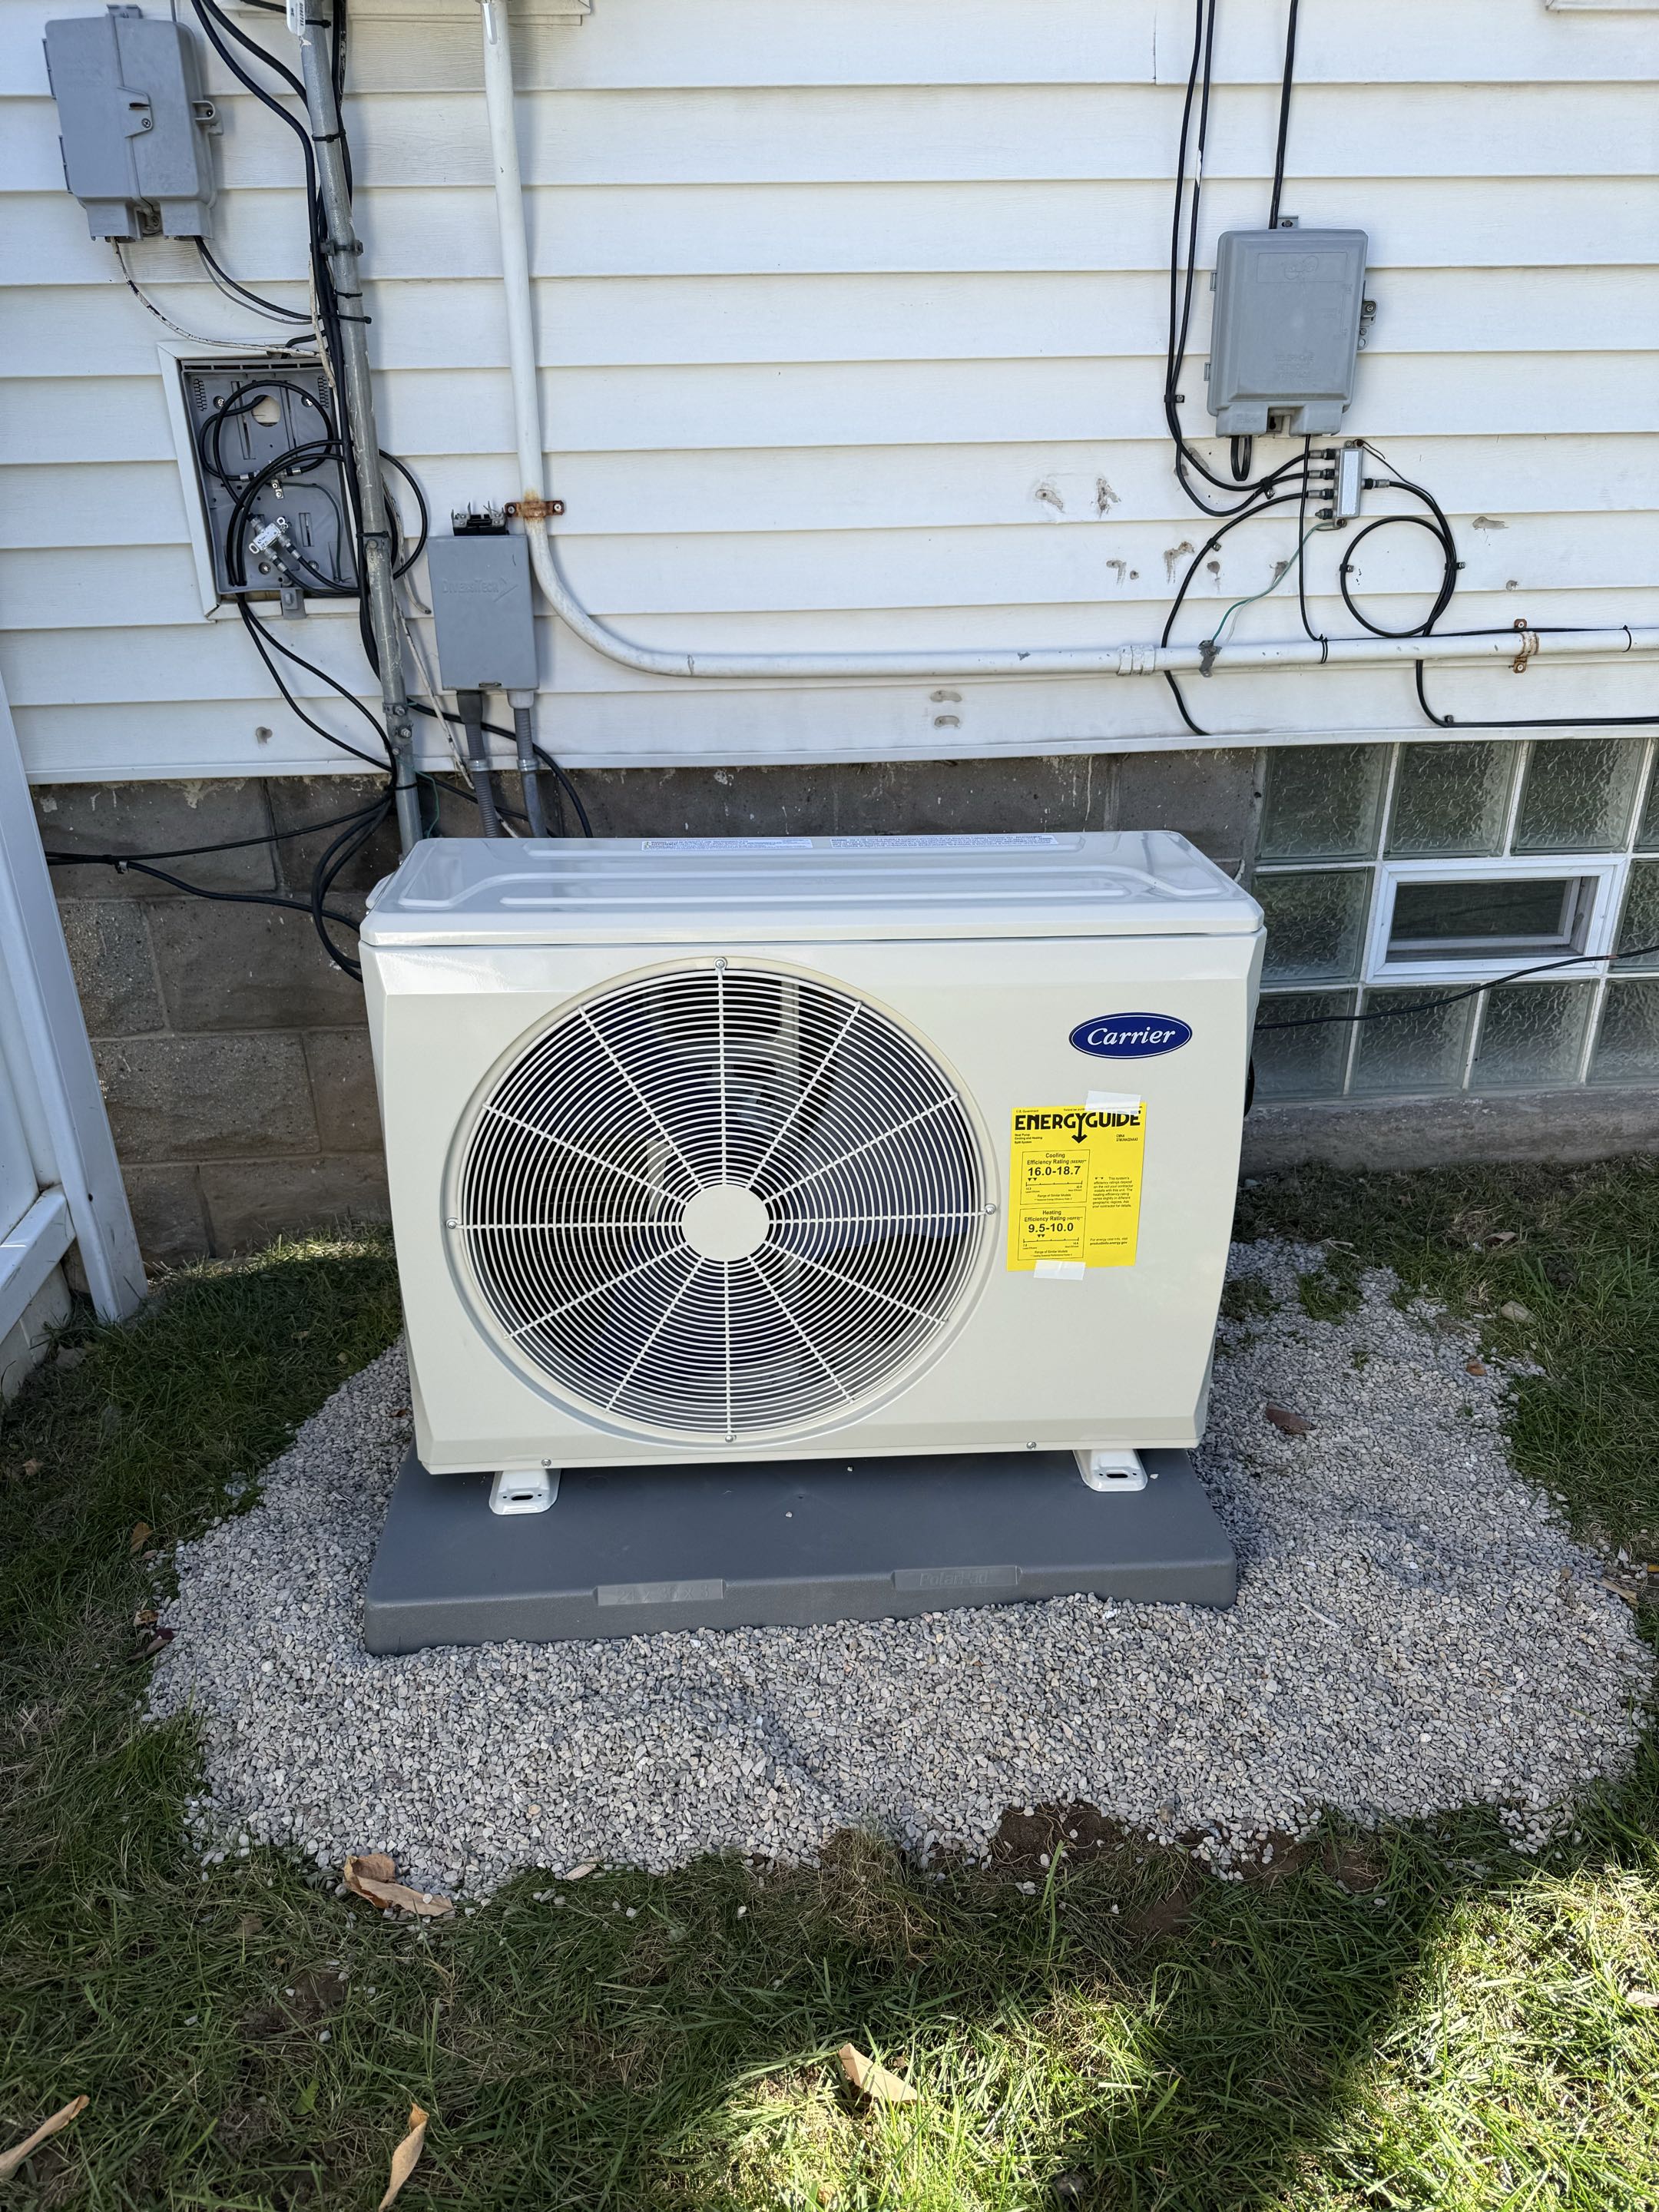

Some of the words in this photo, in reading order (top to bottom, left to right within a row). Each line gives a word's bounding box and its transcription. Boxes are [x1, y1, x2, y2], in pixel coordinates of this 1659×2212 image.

[1087, 1026, 1176, 1046] Carrier
[1015, 1111, 1141, 1131] ENERGYGUIDE
[1028, 1166, 1081, 1176] 16.0-18.7
[1028, 1222, 1074, 1233] 9.5-10.0
[616, 1590, 635, 1604] 24
[700, 1584, 710, 1597] 3
